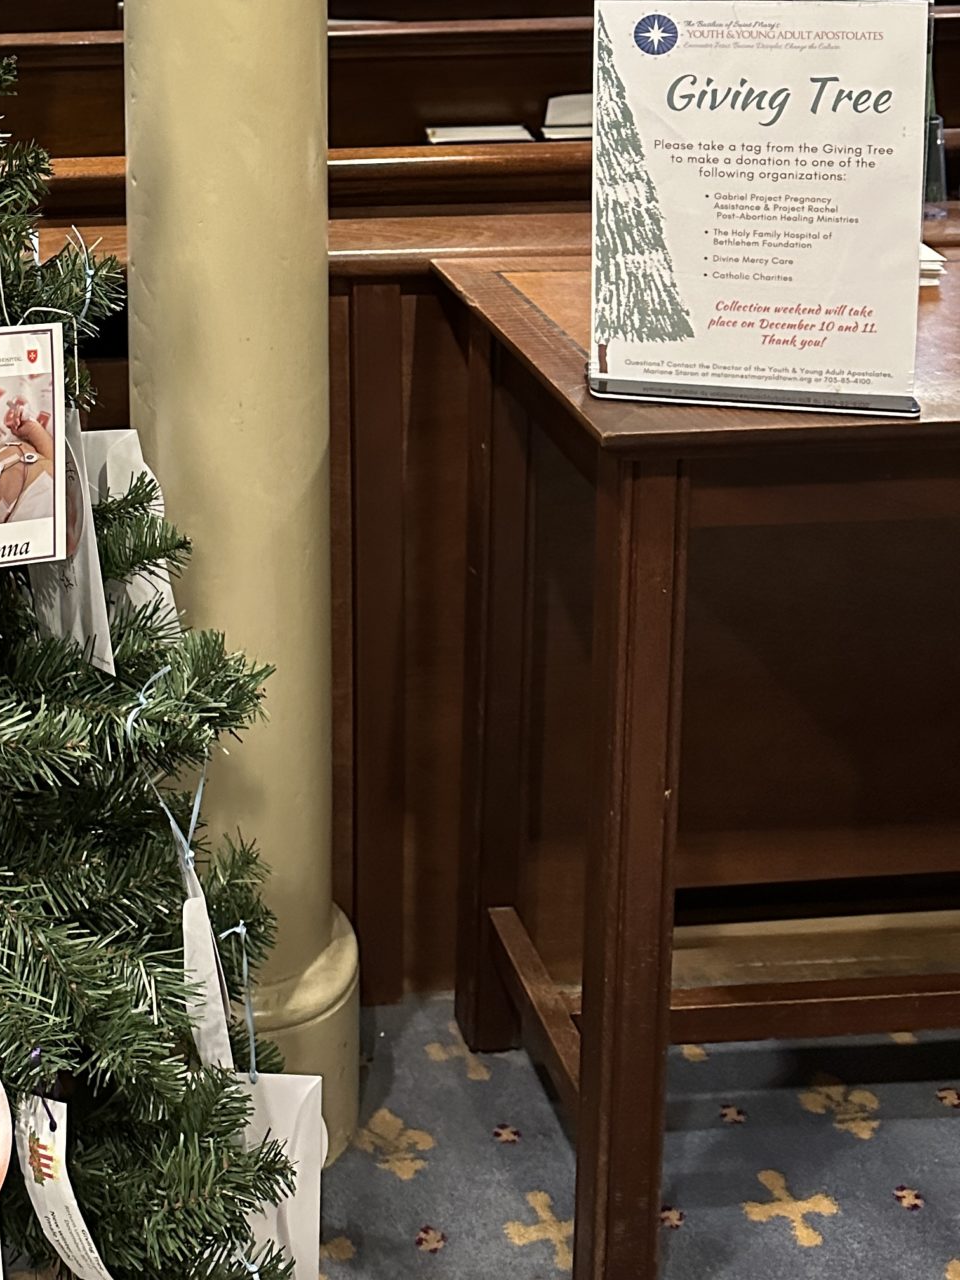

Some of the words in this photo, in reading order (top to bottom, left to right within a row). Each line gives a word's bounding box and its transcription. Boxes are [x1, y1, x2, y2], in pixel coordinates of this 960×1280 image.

[687, 29, 724, 39] YOUTH
[726, 30, 735, 39] &
[735, 30, 776, 39] YOUNG
[777, 30, 812, 40] ADULT
[813, 30, 884, 41] APOSTOLATES
[666, 74, 791, 127] Giving
[809, 76, 893, 115] Tree
[654, 140, 694, 151] Please
[698, 141, 724, 152] take
[728, 144, 736, 152] a
[741, 142, 761, 155] tag
[766, 142, 794, 153] from
[798, 143, 818, 153] the
[822, 144, 862, 157] Giving
[866, 144, 894, 155] Tree
[670, 154, 683, 164] to
[687, 154, 719, 165] make
[723, 157, 731, 165] a
[735, 155, 791, 166] donation
[795, 157, 807, 167] to
[811, 159, 834, 168] one
[838, 157, 852, 168] of
[856, 157, 876, 168] the
[698, 167, 755, 182] following
[758, 170, 847, 184] organizations:
[714, 192, 747, 201] Gabriel
[750, 194, 782, 203] Project
[784, 195, 832, 205] Pregnancy
[713, 202, 761, 211] Assistance
[773, 204, 805, 213] Project
[807, 205, 839, 213] Rachel
[716, 212, 778, 221] Post-Abortion
[780, 214, 814, 224] Healing
[816, 215, 859, 224] Ministries
[713, 228, 728, 236] The
[731, 229, 750, 239] Holy
[753, 230, 781, 240] Family
[783, 231, 820, 241] Hospital
[823, 232, 832, 240] of
[713, 238, 759, 247] Bethlehem
[762, 240, 812, 249] Foundation
[712, 254, 740, 263] Divine
[742, 256, 769, 266] Mercy
[771, 257, 794, 265] Care
[712, 271, 750, 280] Catholic
[752, 273, 793, 282] Charities
[715, 300, 771, 313] Collection
[774, 303, 822, 315] weekend
[825, 304, 846, 316] will
[848, 305, 873, 317] take
[707, 316, 737, 329] place
[759, 319, 816, 331] December
[818, 321, 834, 331] 10
[837, 322, 858, 333] and
[861, 323, 877, 333] 11.
[761, 334, 797, 347] Thank
[800, 336, 827, 350] you!
[624, 358, 664, 367] Questions?
[666, 361, 696, 369] Contact
[698, 362, 710, 370] the
[712, 363, 742, 371] Director
[768, 366, 789, 374] Youth
[800, 368, 823, 376] Young
